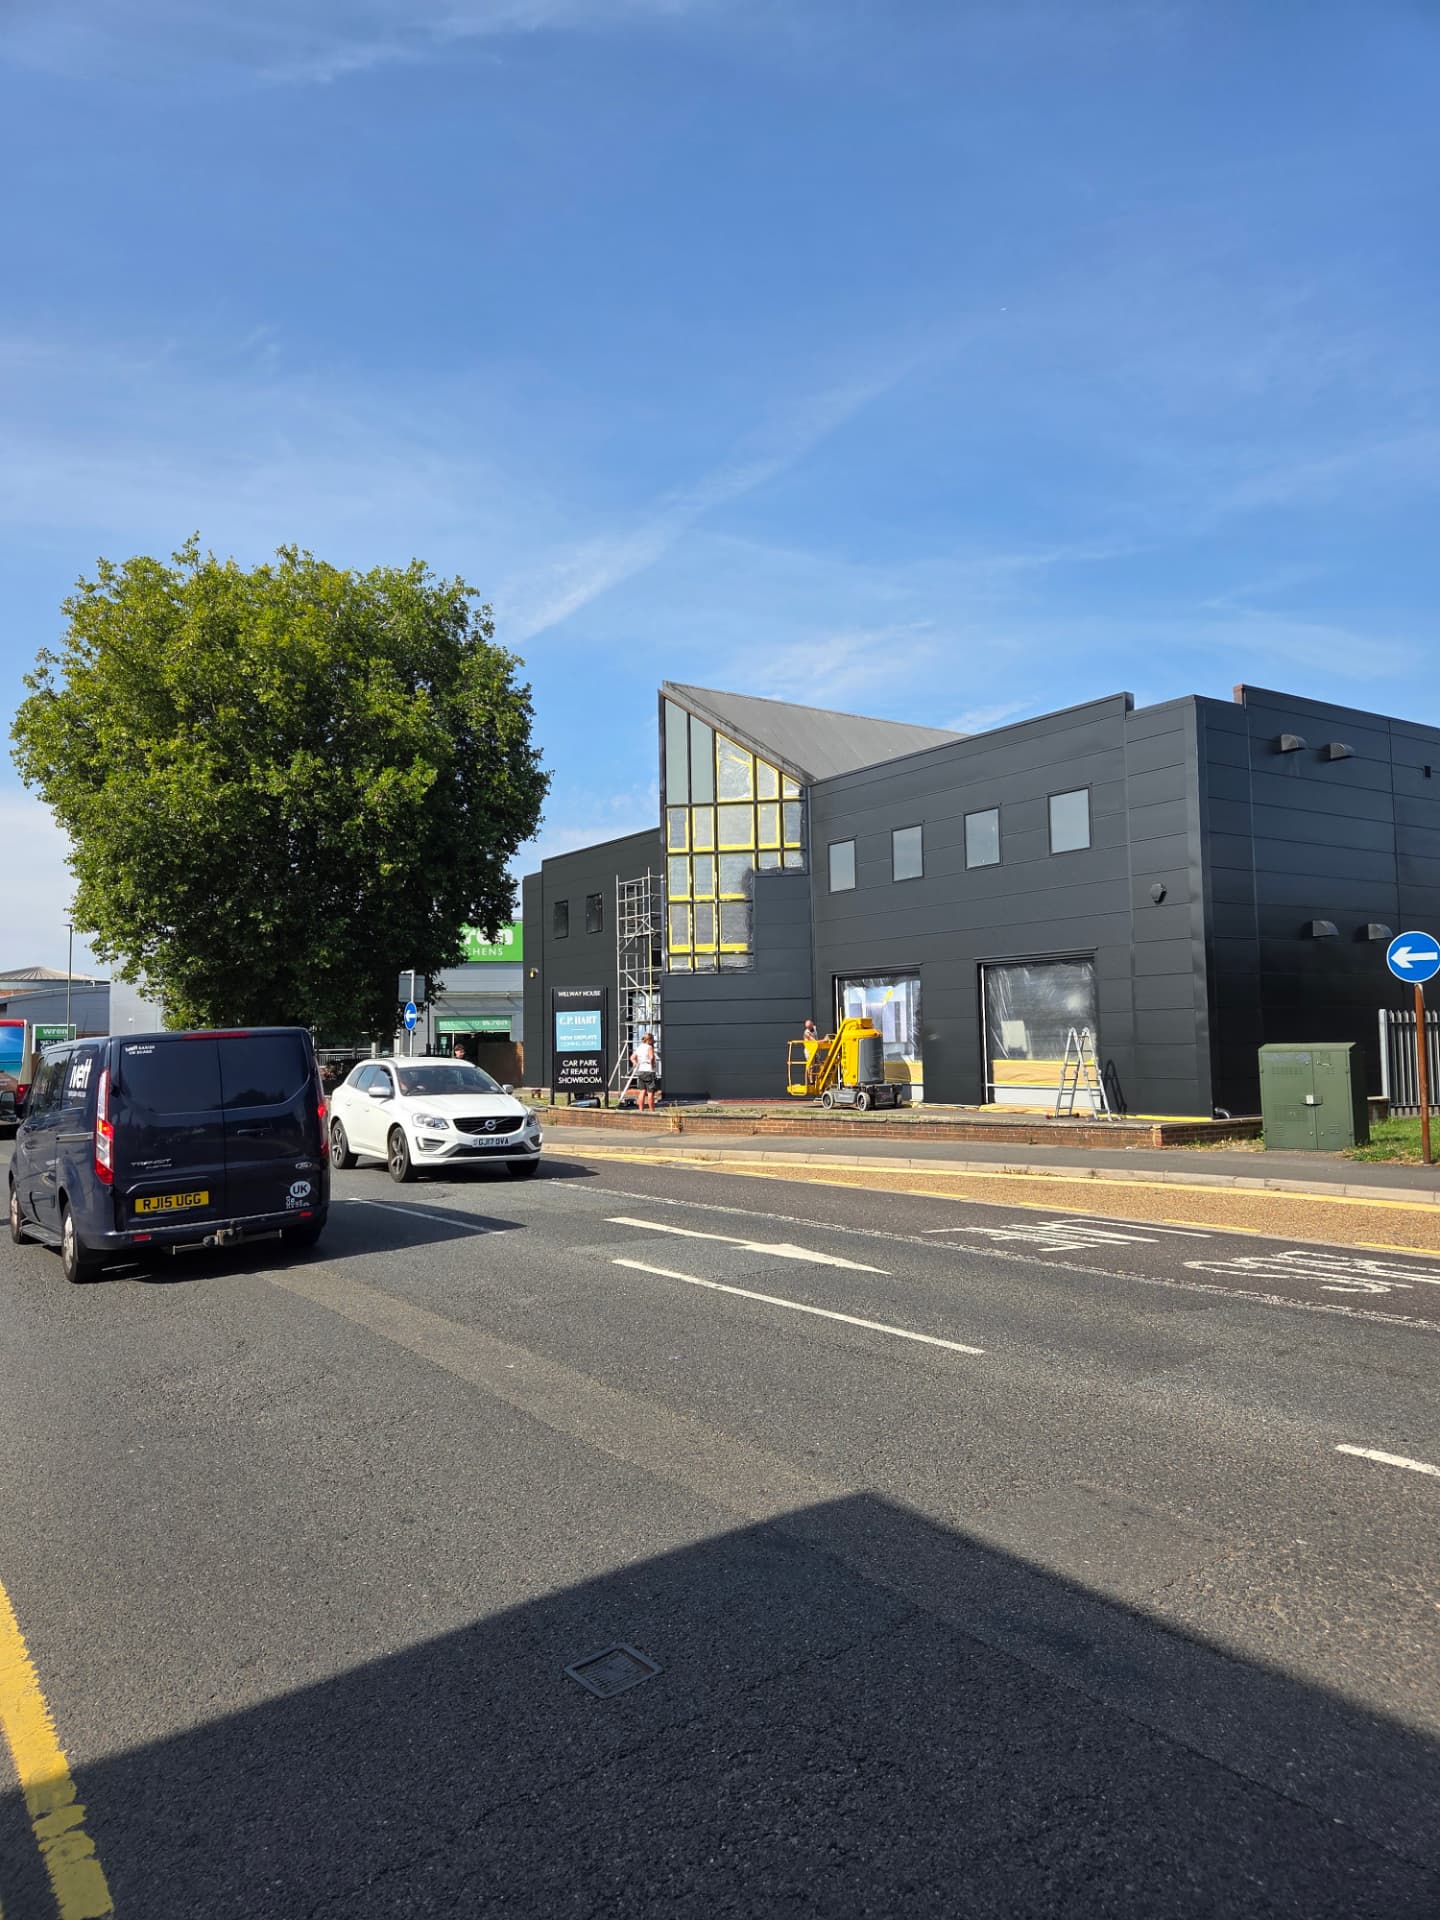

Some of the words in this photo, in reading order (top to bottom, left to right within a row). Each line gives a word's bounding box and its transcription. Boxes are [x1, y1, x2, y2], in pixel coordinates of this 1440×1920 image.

[562, 1059, 578, 1067] CAR
[579, 1059, 598, 1067] PARK
[560, 1068, 570, 1076] AT
[570, 1067, 588, 1075] REAR
[589, 1067, 600, 1075] OF
[558, 1076, 603, 1084] SHOWROOM
[292, 1184, 308, 1195] UK
[143, 1197, 172, 1210] RJ15
[176, 1193, 201, 1206] UGG
